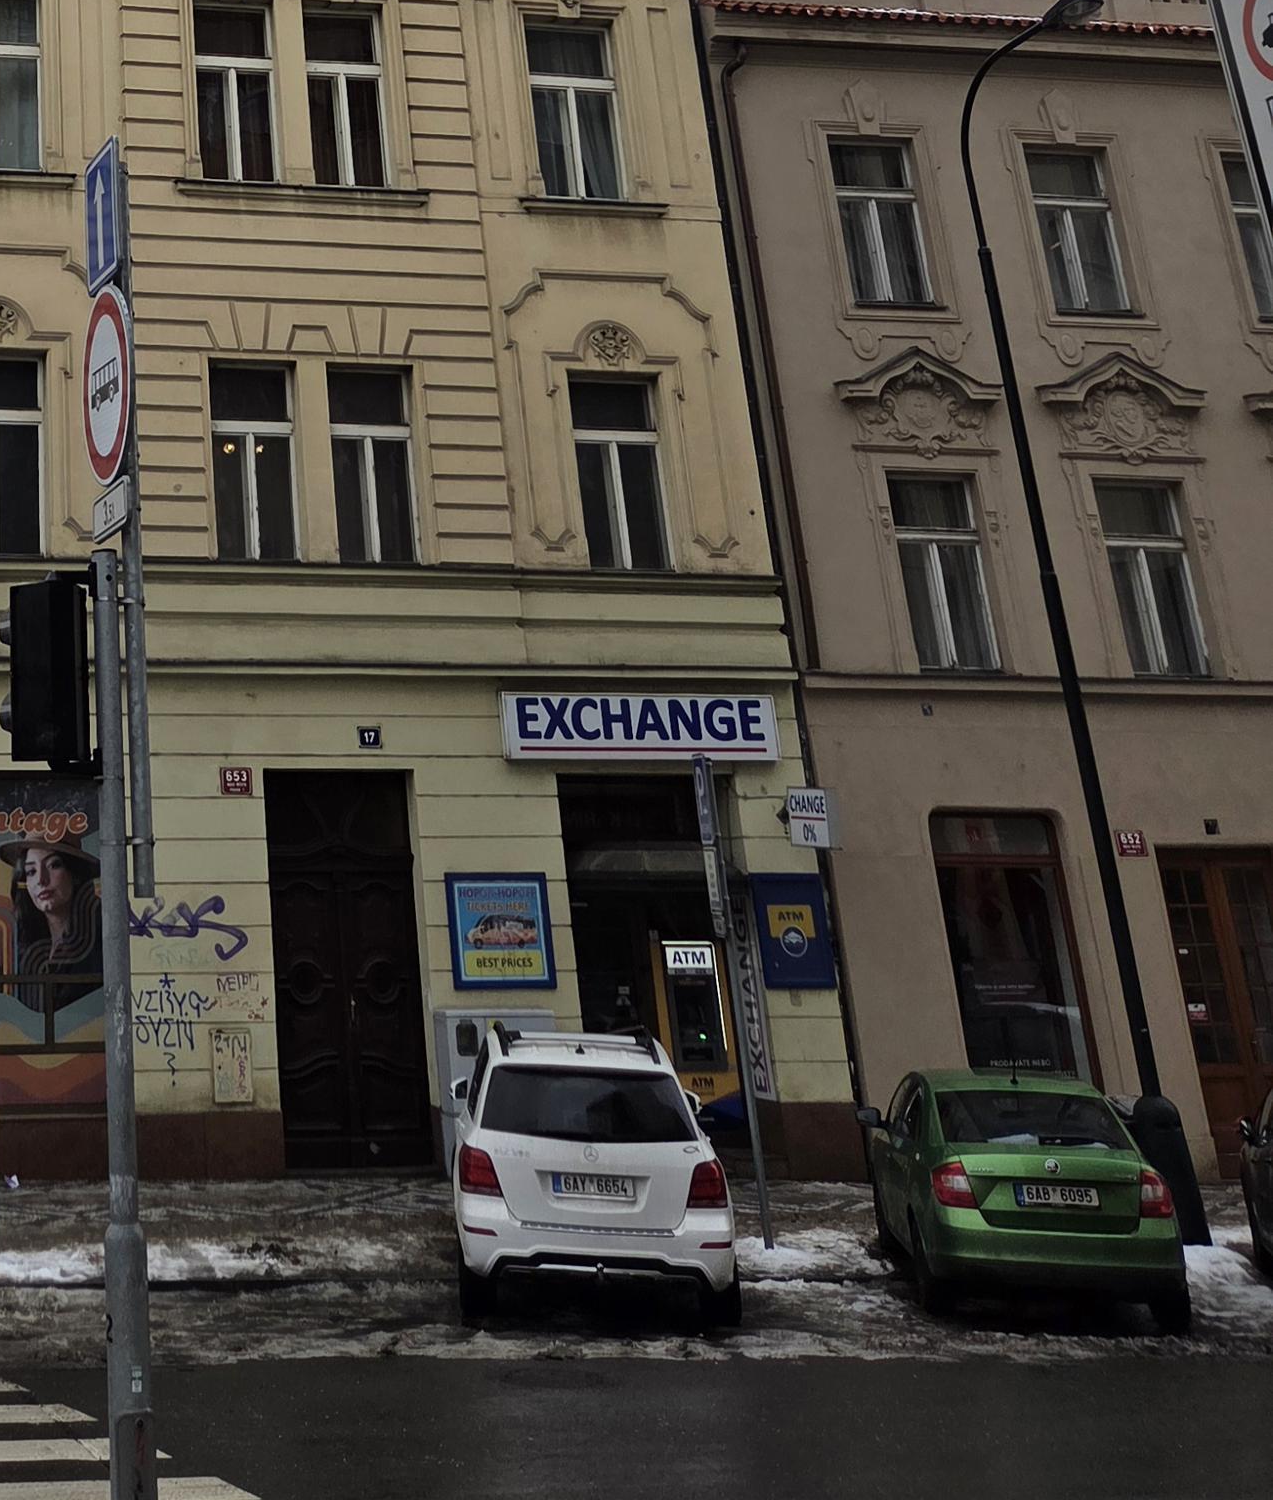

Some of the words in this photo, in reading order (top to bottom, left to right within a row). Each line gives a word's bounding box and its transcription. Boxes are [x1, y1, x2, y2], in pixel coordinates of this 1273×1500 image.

[516, 697, 766, 741] EXCHANGE
[364, 731, 375, 743] 17
[226, 770, 247, 782] 653
[789, 794, 825, 814] CHANGE
[803, 823, 817, 843] 0%
[1120, 832, 1141, 844] 652
[777, 910, 804, 922] ATM
[476, 957, 498, 968] BEST
[501, 957, 533, 968] PRICES
[672, 951, 706, 965] ATM
[730, 893, 767, 1092] EXCHANGE
[691, 1077, 714, 1089] ATM
[563, 1176, 586, 1192] 6AY
[596, 1177, 628, 1195] 6654
[1026, 1186, 1050, 1201] 6AB
[1060, 1187, 1093, 1203] 6095
